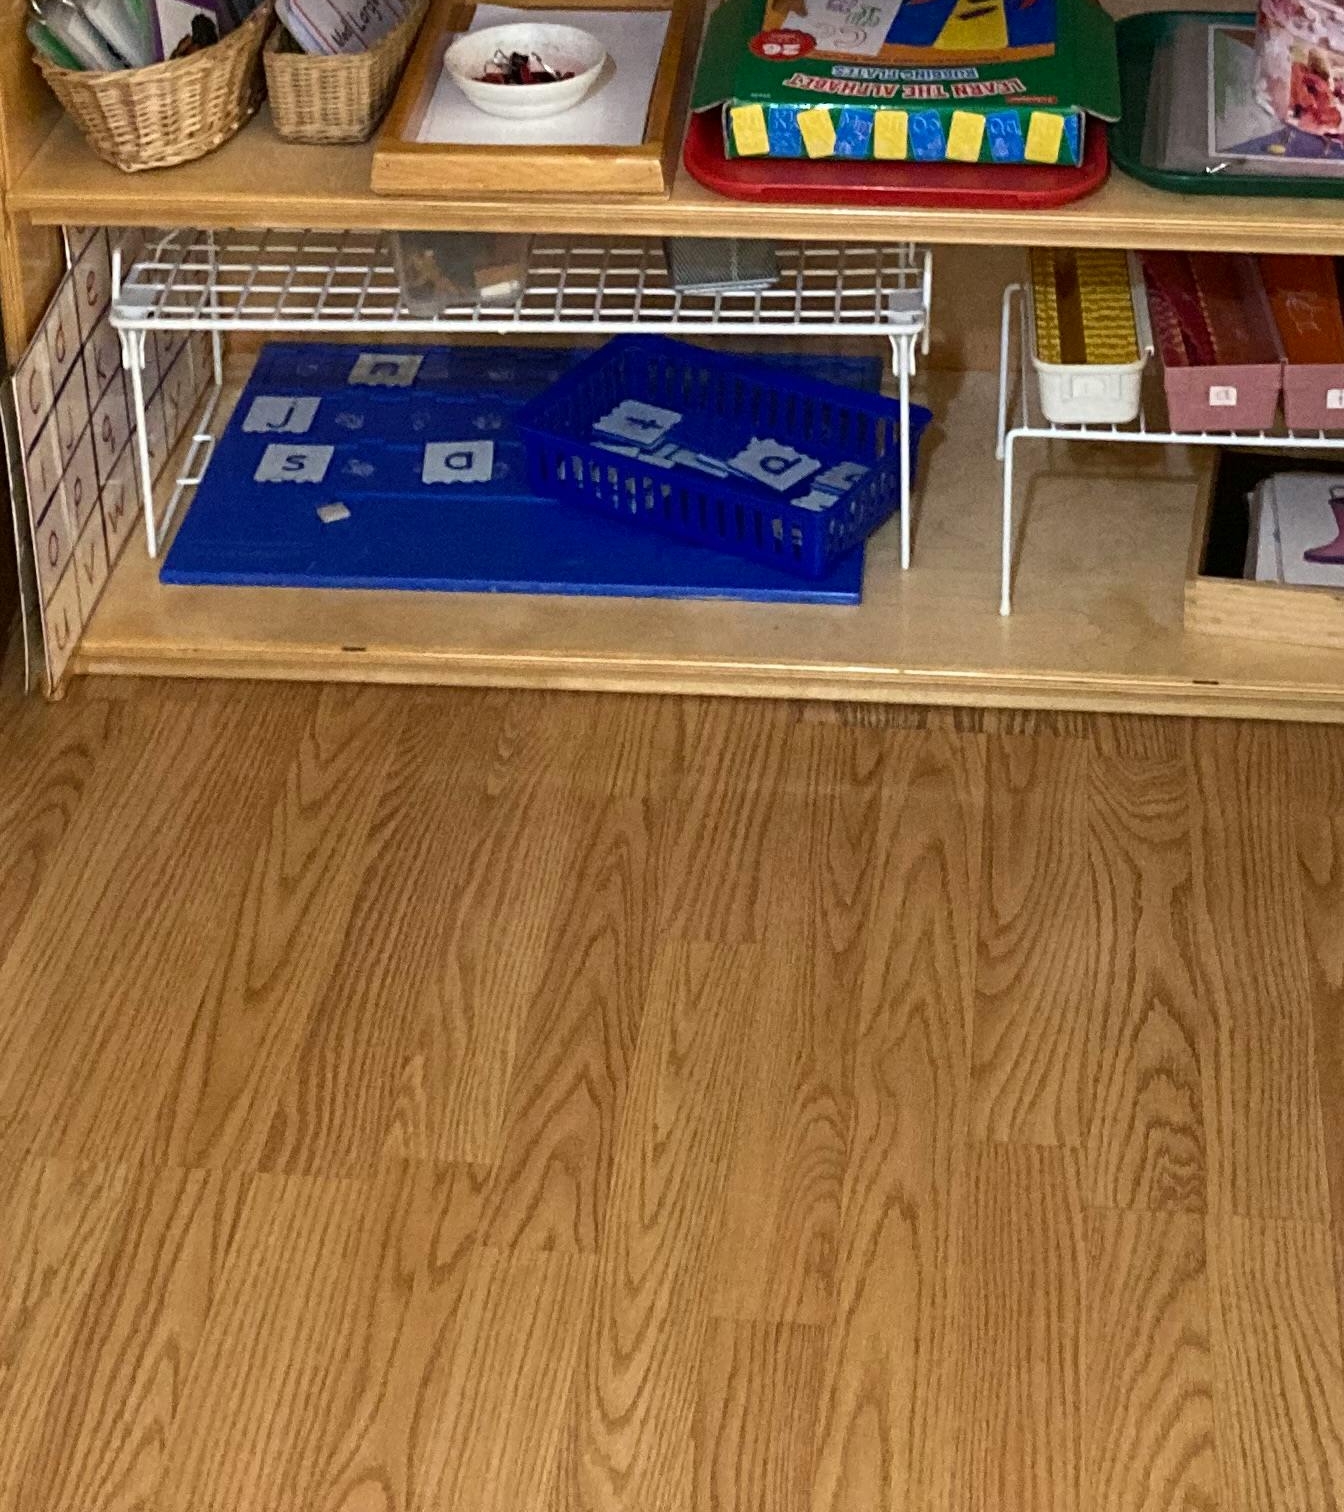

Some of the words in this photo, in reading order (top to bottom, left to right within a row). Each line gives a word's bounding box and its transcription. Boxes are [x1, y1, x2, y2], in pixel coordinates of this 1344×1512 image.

[762, 42, 802, 57] 26
[782, 71, 902, 100] ALPHABET
[901, 82, 951, 100] THE
[952, 76, 1028, 100] LEARN
[281, 454, 308, 472] s
[443, 450, 474, 470] a
